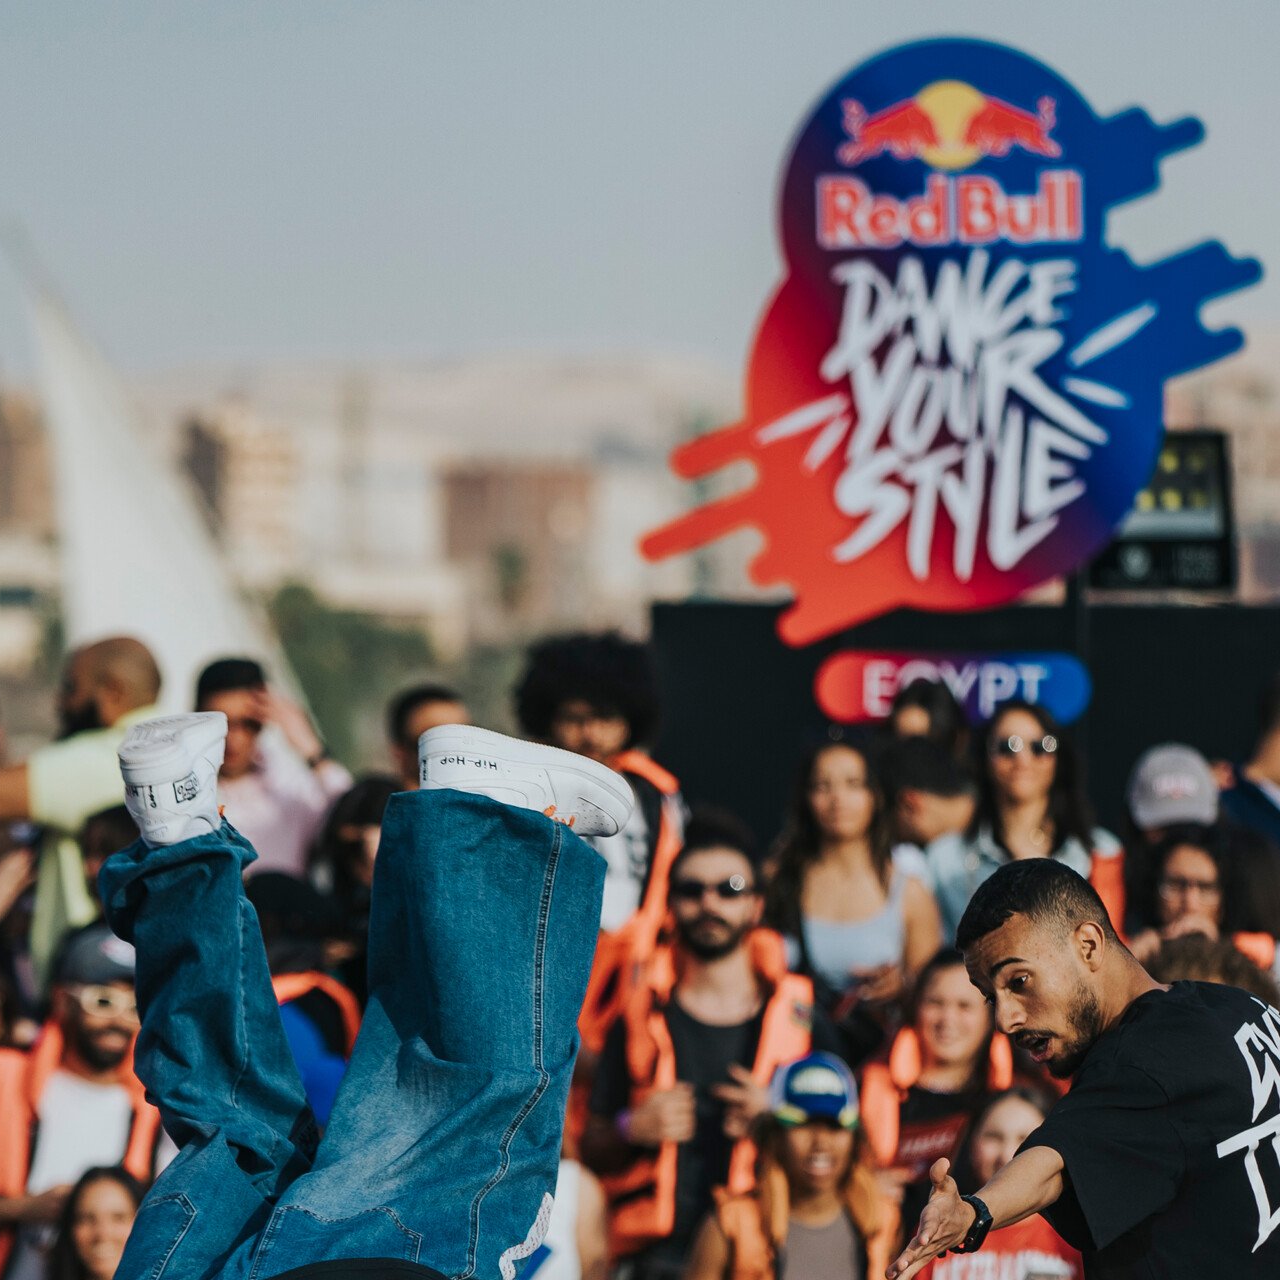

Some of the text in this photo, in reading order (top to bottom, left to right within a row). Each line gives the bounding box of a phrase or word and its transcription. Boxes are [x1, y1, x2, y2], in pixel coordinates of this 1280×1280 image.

[818, 168, 1084, 248] Red Bull
[820, 246, 1076, 382] DANCE
[845, 328, 1109, 478] YOUR
[832, 404, 1092, 584] STYLE
